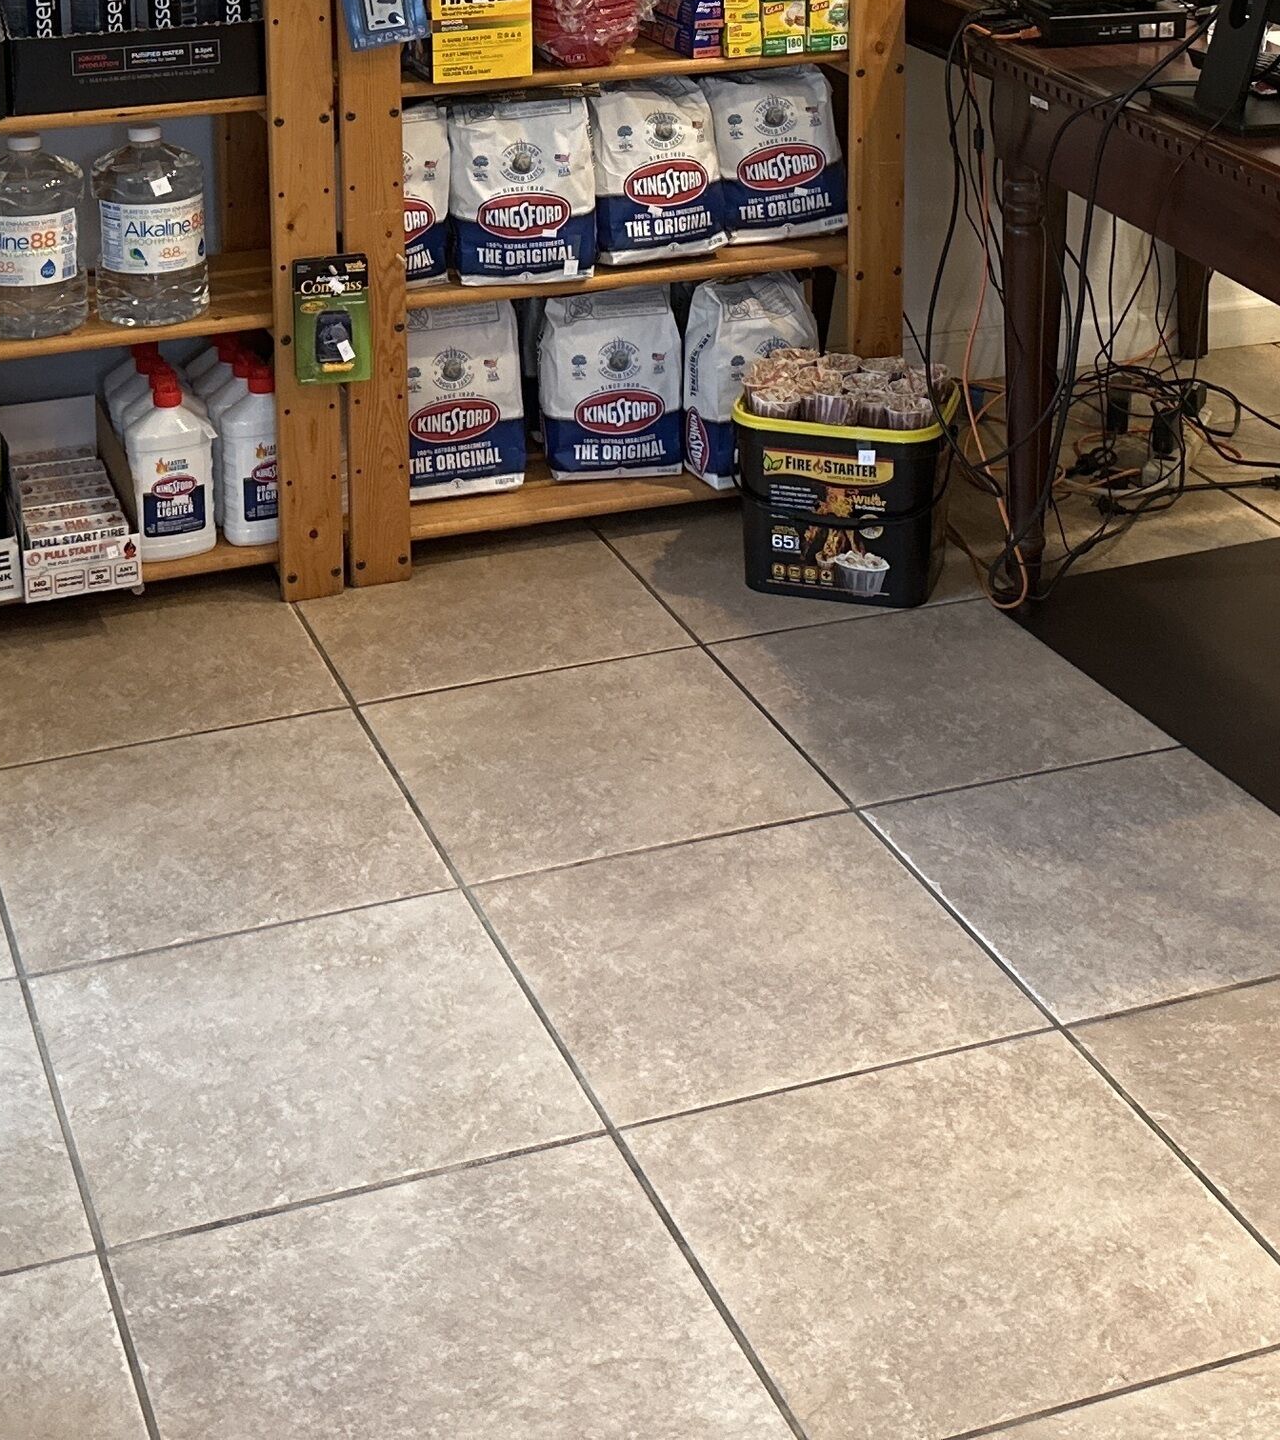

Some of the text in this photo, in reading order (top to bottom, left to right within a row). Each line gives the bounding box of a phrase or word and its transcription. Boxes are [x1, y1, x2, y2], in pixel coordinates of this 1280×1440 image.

[765, 4, 784, 15] GLAD
[787, 38, 802, 49] 180
[832, 35, 846, 46] 50
[744, 152, 818, 182] KINGSFORD
[633, 168, 702, 198] KINGSFORD
[485, 202, 562, 231] KINGSFORD
[739, 194, 832, 221] THE ORIGINAL
[624, 213, 713, 238] THE ORIGINAL
[477, 245, 576, 265] THE ORIGINAL
[417, 406, 491, 436] KINGSFORD
[583, 398, 657, 427] KINGSFORD
[573, 439, 666, 460] THE ORIGINAL
[410, 448, 502, 474] THE ORIGINAL
[785, 455, 877, 478] FIRE STARTER
[156, 479, 194, 494] KINGSFORD
[156, 503, 194, 518] LIGHTER
[31, 527, 125, 549] PULL START FIRE
[771, 534, 794, 549] 65
[44, 545, 97, 560] PULL START
